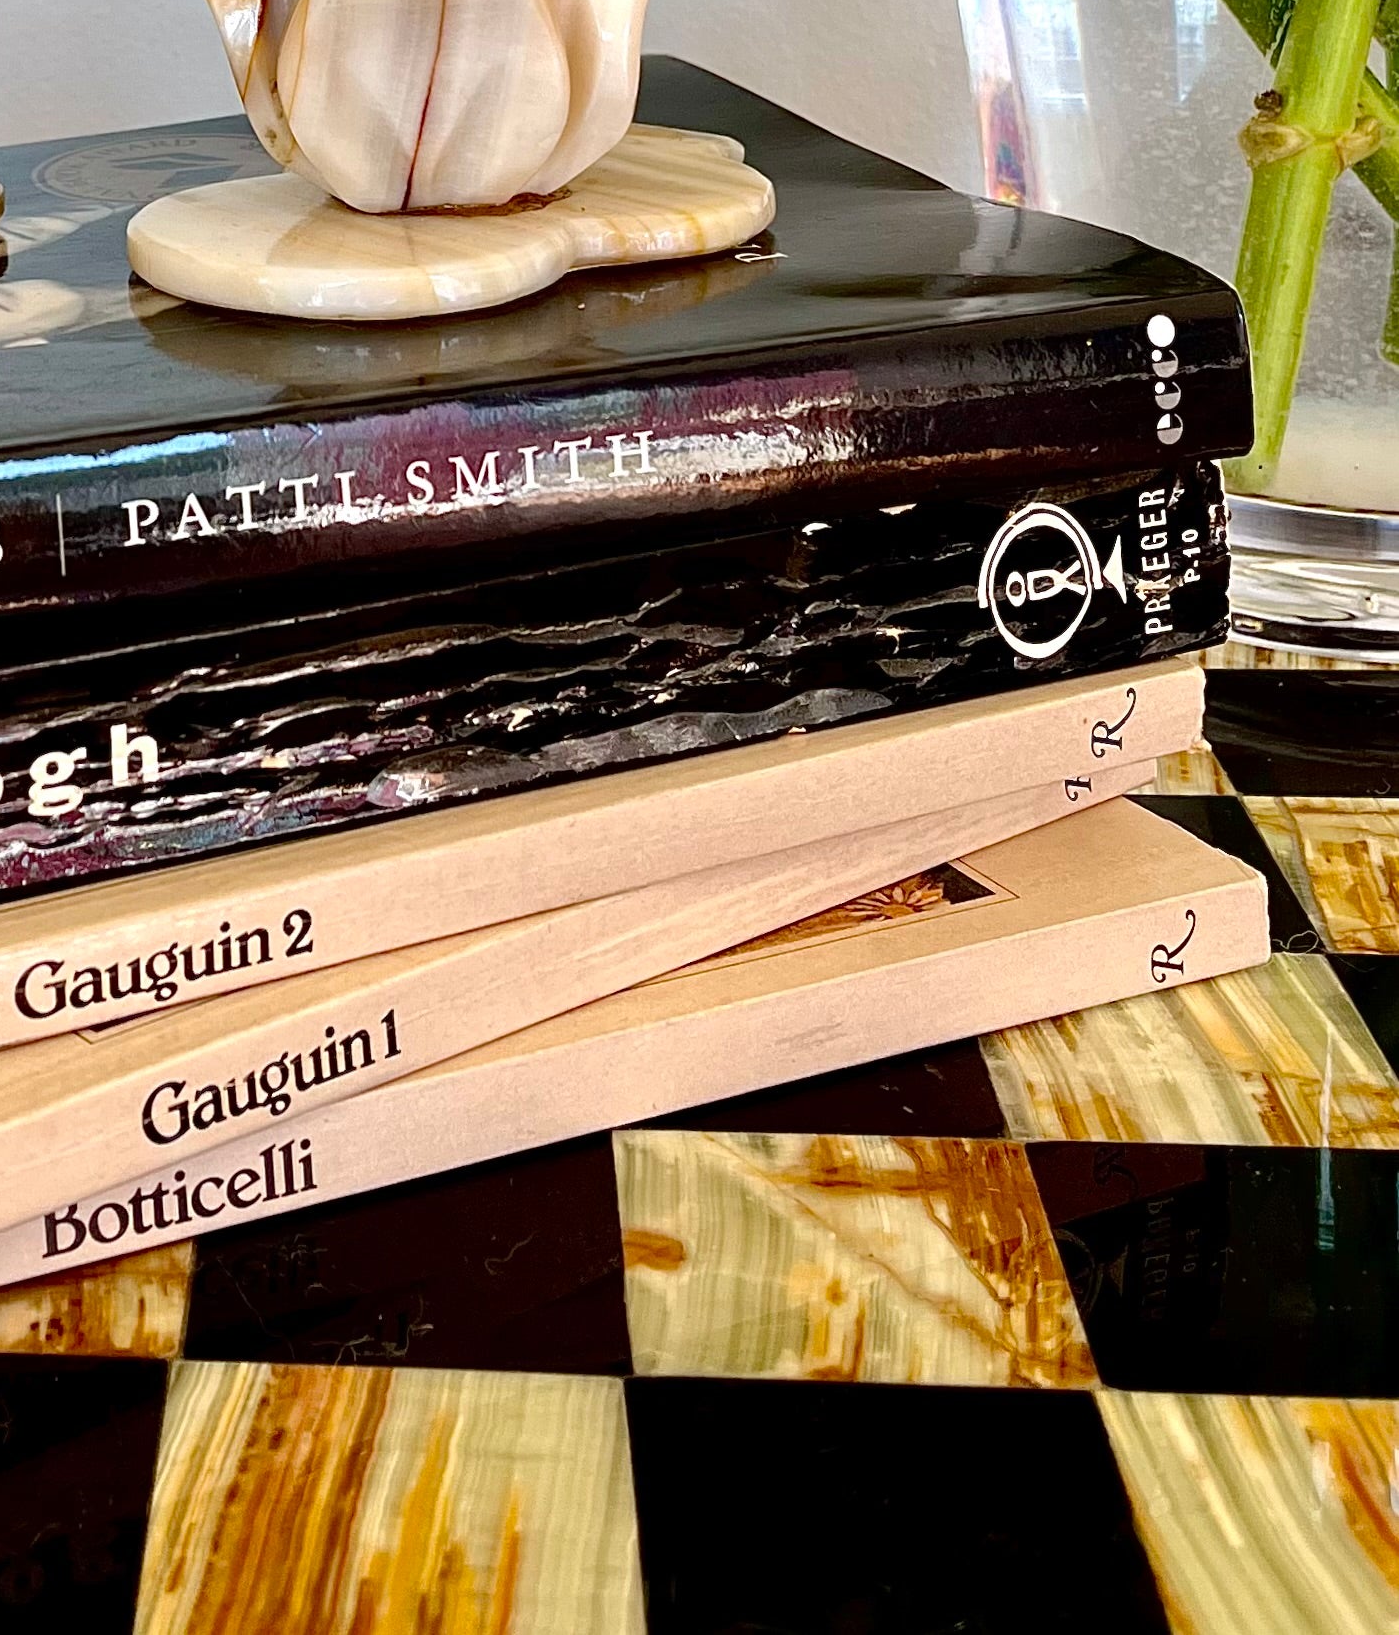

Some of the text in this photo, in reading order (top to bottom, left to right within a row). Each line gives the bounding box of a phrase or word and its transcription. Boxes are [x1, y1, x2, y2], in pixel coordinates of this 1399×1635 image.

[121, 430, 660, 548] PATTI SMITH
[1136, 488, 1174, 636] PRAEGER
[1181, 528, 1202, 584] P-10
[13, 908, 315, 1021] Gauguin 2
[140, 1008, 402, 1146] Gauguin 1
[41, 1137, 318, 1259] Botticelli
